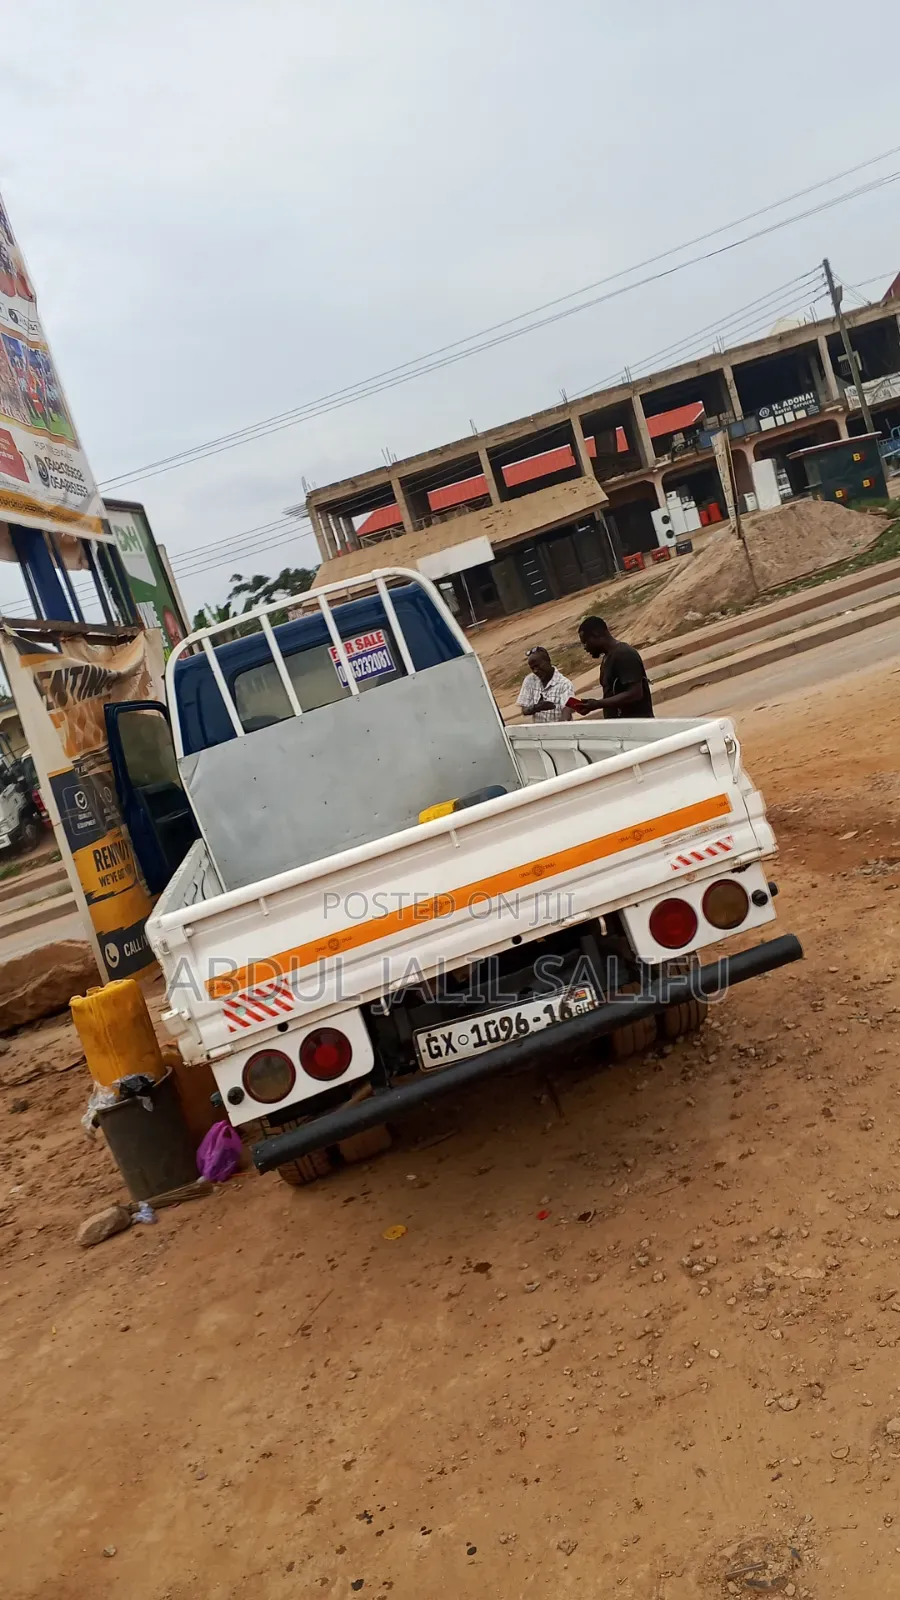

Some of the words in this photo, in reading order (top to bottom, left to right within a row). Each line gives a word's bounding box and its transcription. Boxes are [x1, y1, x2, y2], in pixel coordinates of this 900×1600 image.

[772, 403, 782, 411] H.
[783, 392, 814, 407] ADONAI
[329, 642, 354, 660] FR
[355, 631, 384, 651] SALE
[337, 649, 391, 683] 03232081
[123, 939, 142, 957] CALL
[425, 1034, 458, 1059] GX
